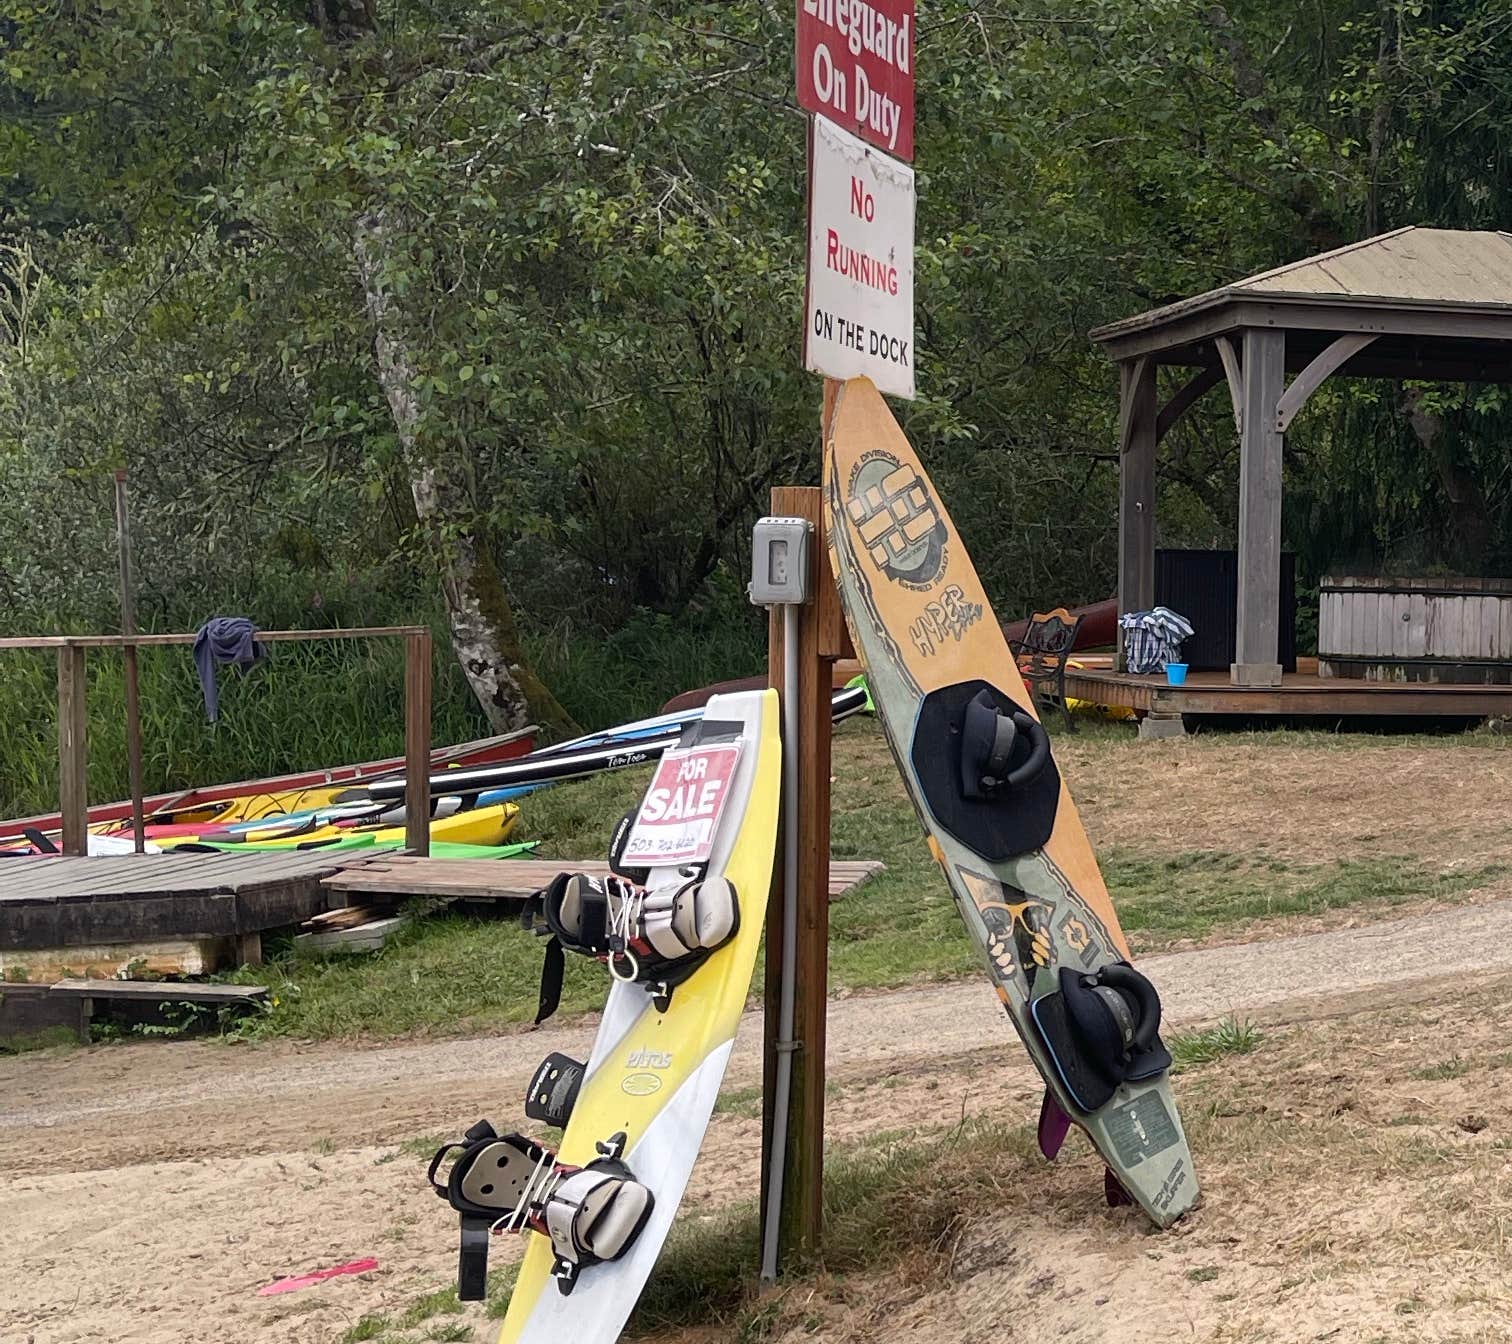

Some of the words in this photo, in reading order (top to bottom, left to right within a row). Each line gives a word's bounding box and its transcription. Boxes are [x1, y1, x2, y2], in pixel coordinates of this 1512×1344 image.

[813, 42, 848, 114] On
[854, 64, 902, 151] Duty
[814, 308, 834, 341] ON
[838, 317, 865, 353] THE
[869, 329, 909, 367] DOCK
[676, 756, 709, 783] FOR
[641, 779, 722, 823] SALE
